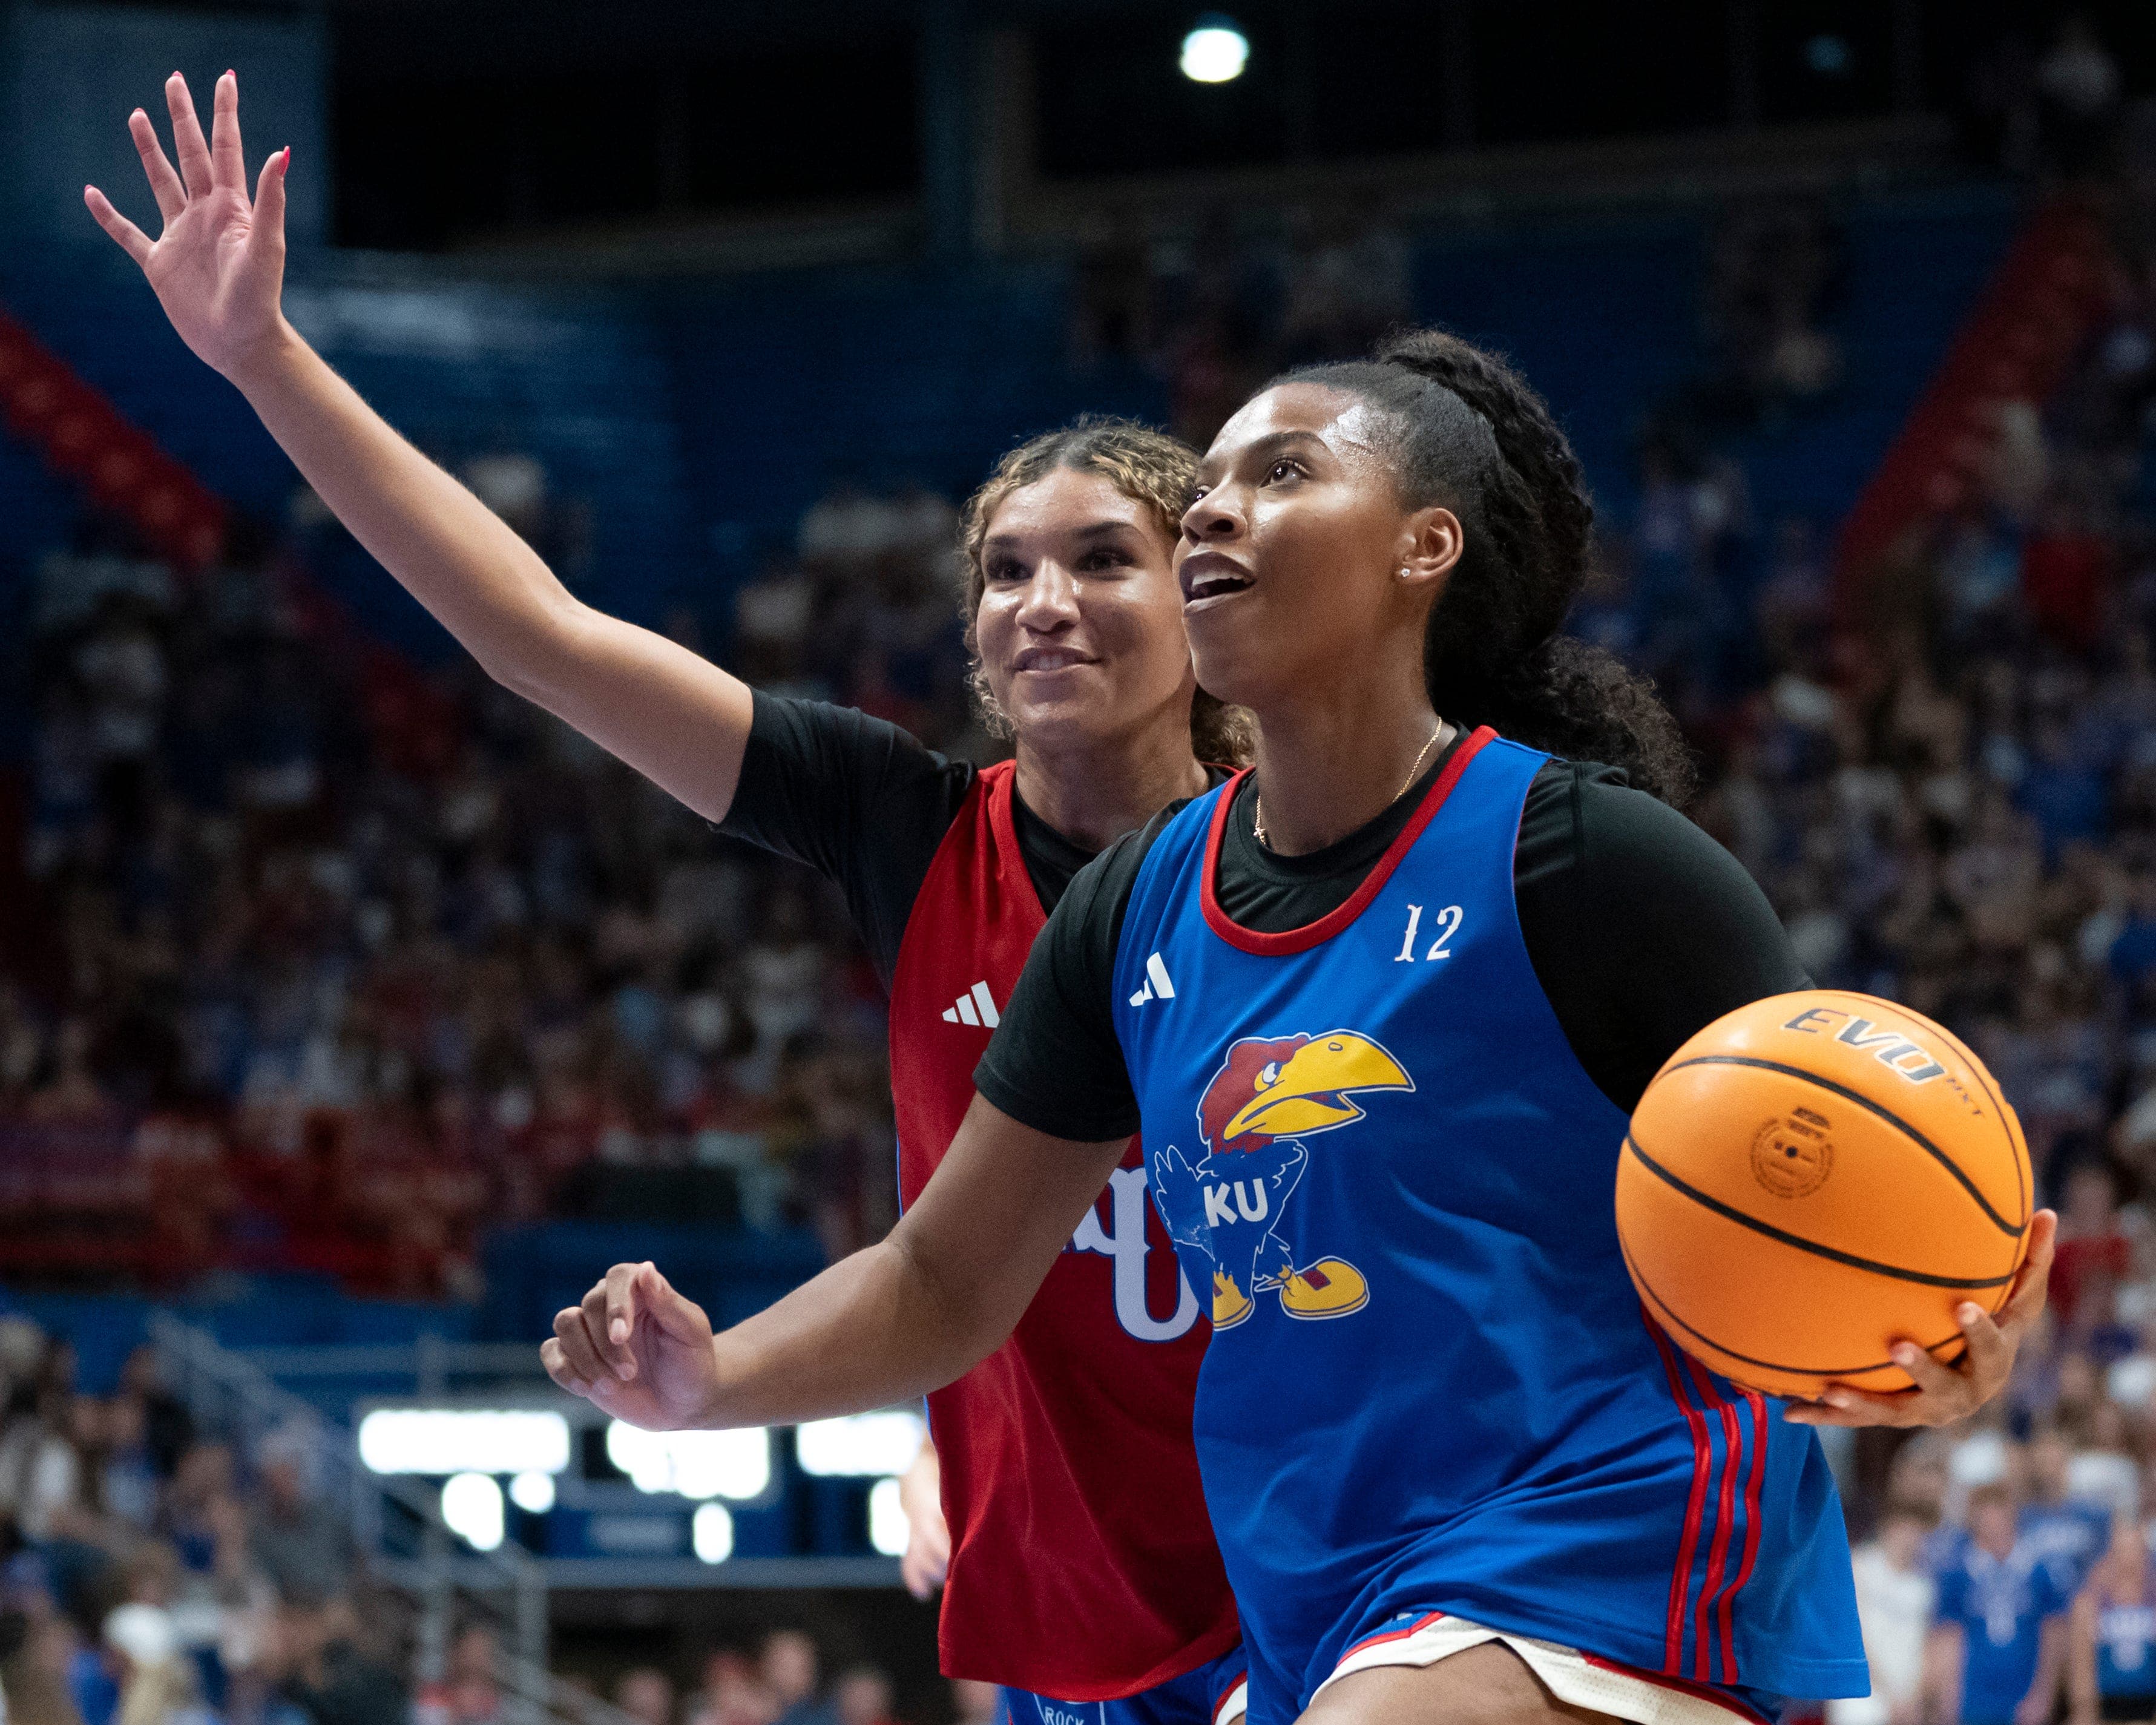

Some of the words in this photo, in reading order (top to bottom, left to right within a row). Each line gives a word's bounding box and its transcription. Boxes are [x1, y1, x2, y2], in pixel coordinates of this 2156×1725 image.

[1394, 903, 1464, 962] 12
[1781, 1007, 1948, 1085] EVO
[1203, 1177, 1269, 1228] KU
[1063, 1166, 1201, 1342] U
